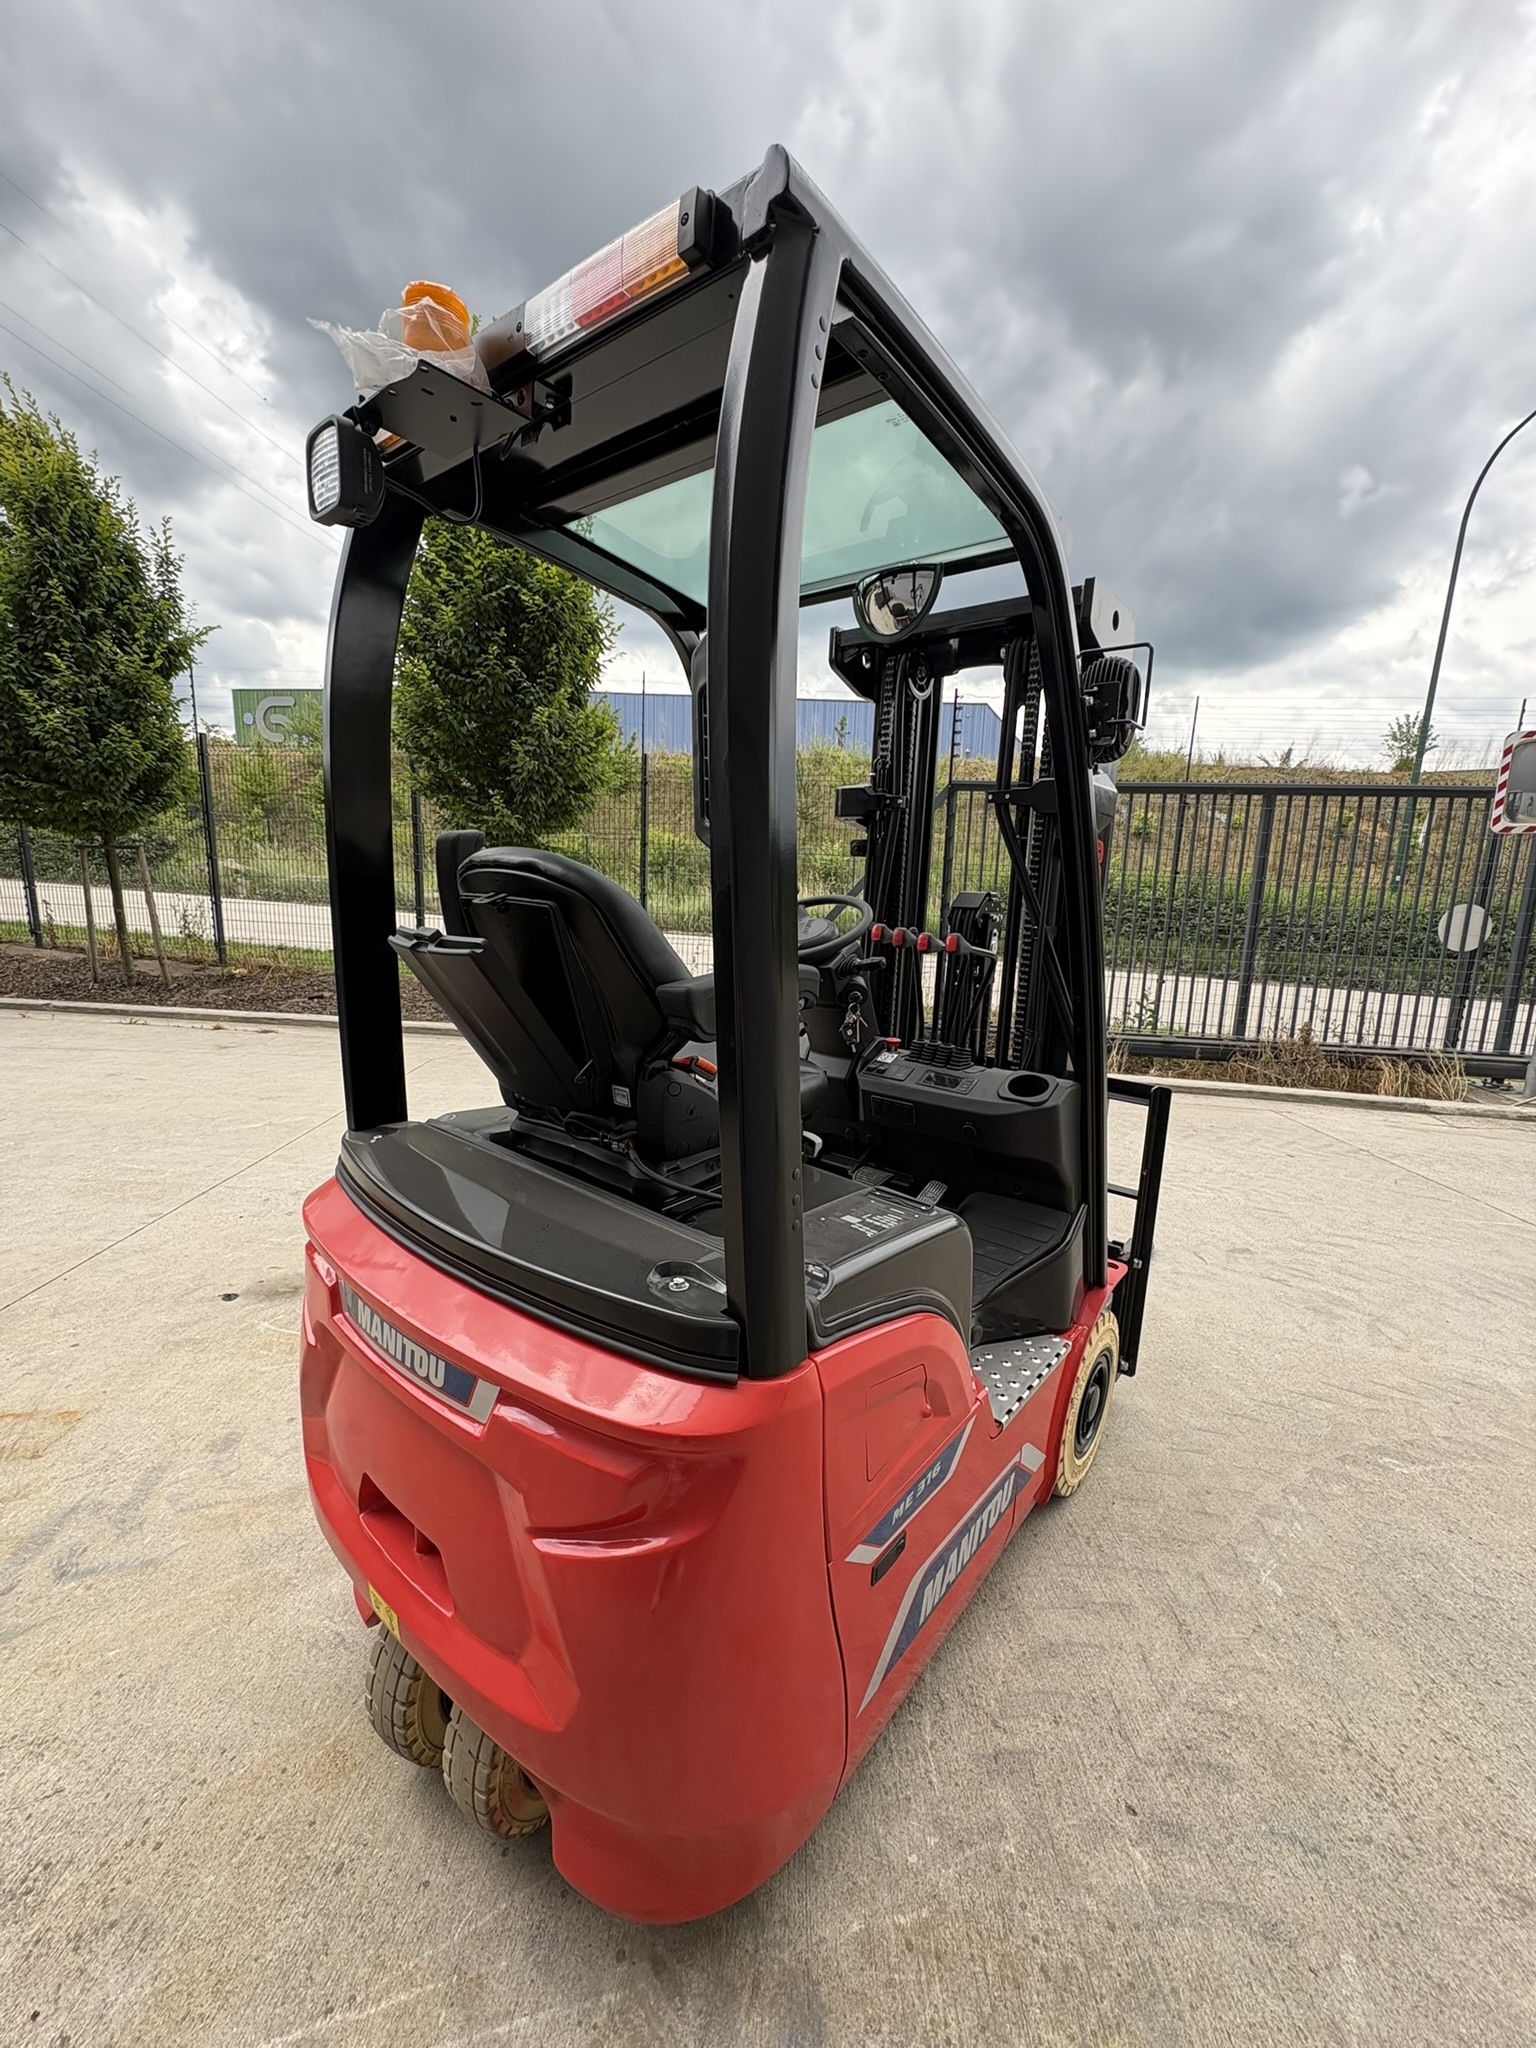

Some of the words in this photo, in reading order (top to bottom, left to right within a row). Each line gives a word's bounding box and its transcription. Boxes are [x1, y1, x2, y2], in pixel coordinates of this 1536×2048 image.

[357, 1300, 446, 1388] MANITOU
[891, 1492, 917, 1526] ME
[915, 1460, 942, 1496] 316
[918, 1471, 1016, 1627] MANITOU
